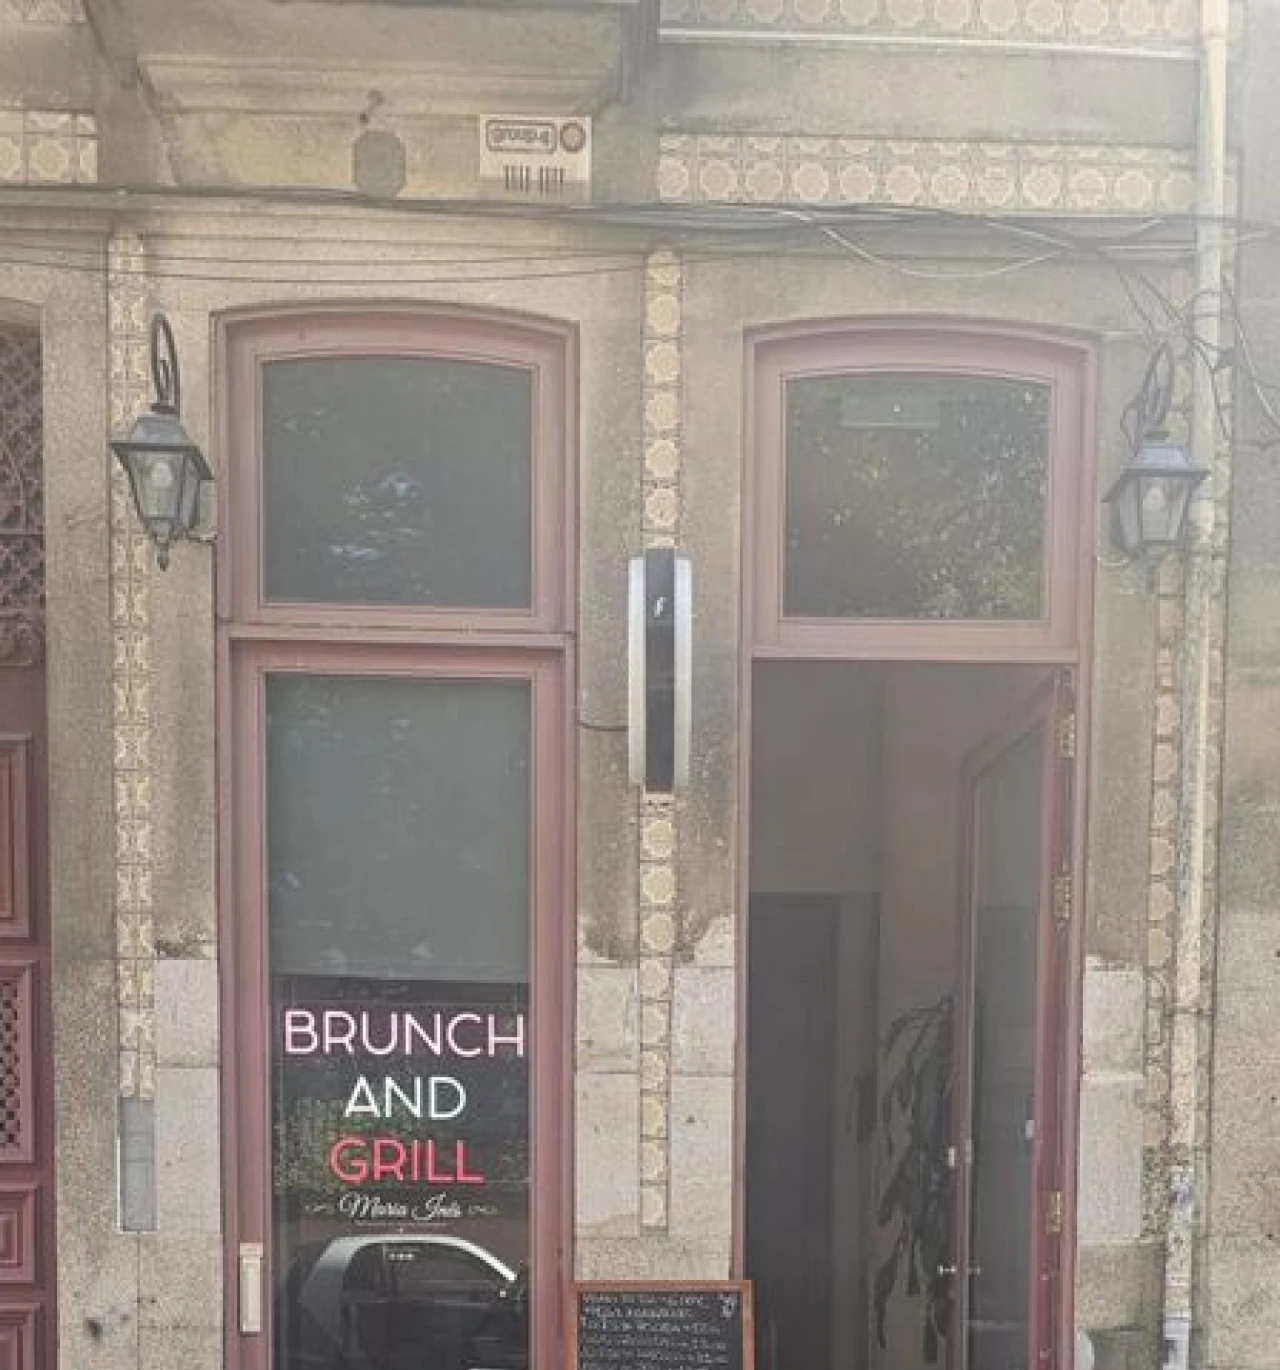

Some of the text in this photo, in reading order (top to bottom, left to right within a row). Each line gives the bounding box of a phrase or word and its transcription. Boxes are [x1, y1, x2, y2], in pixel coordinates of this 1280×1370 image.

[285, 1010, 524, 1057] BRUNCH
[344, 1074, 467, 1119] AND
[329, 1137, 486, 1183] GRILL
[339, 1191, 407, 1217] Maria
